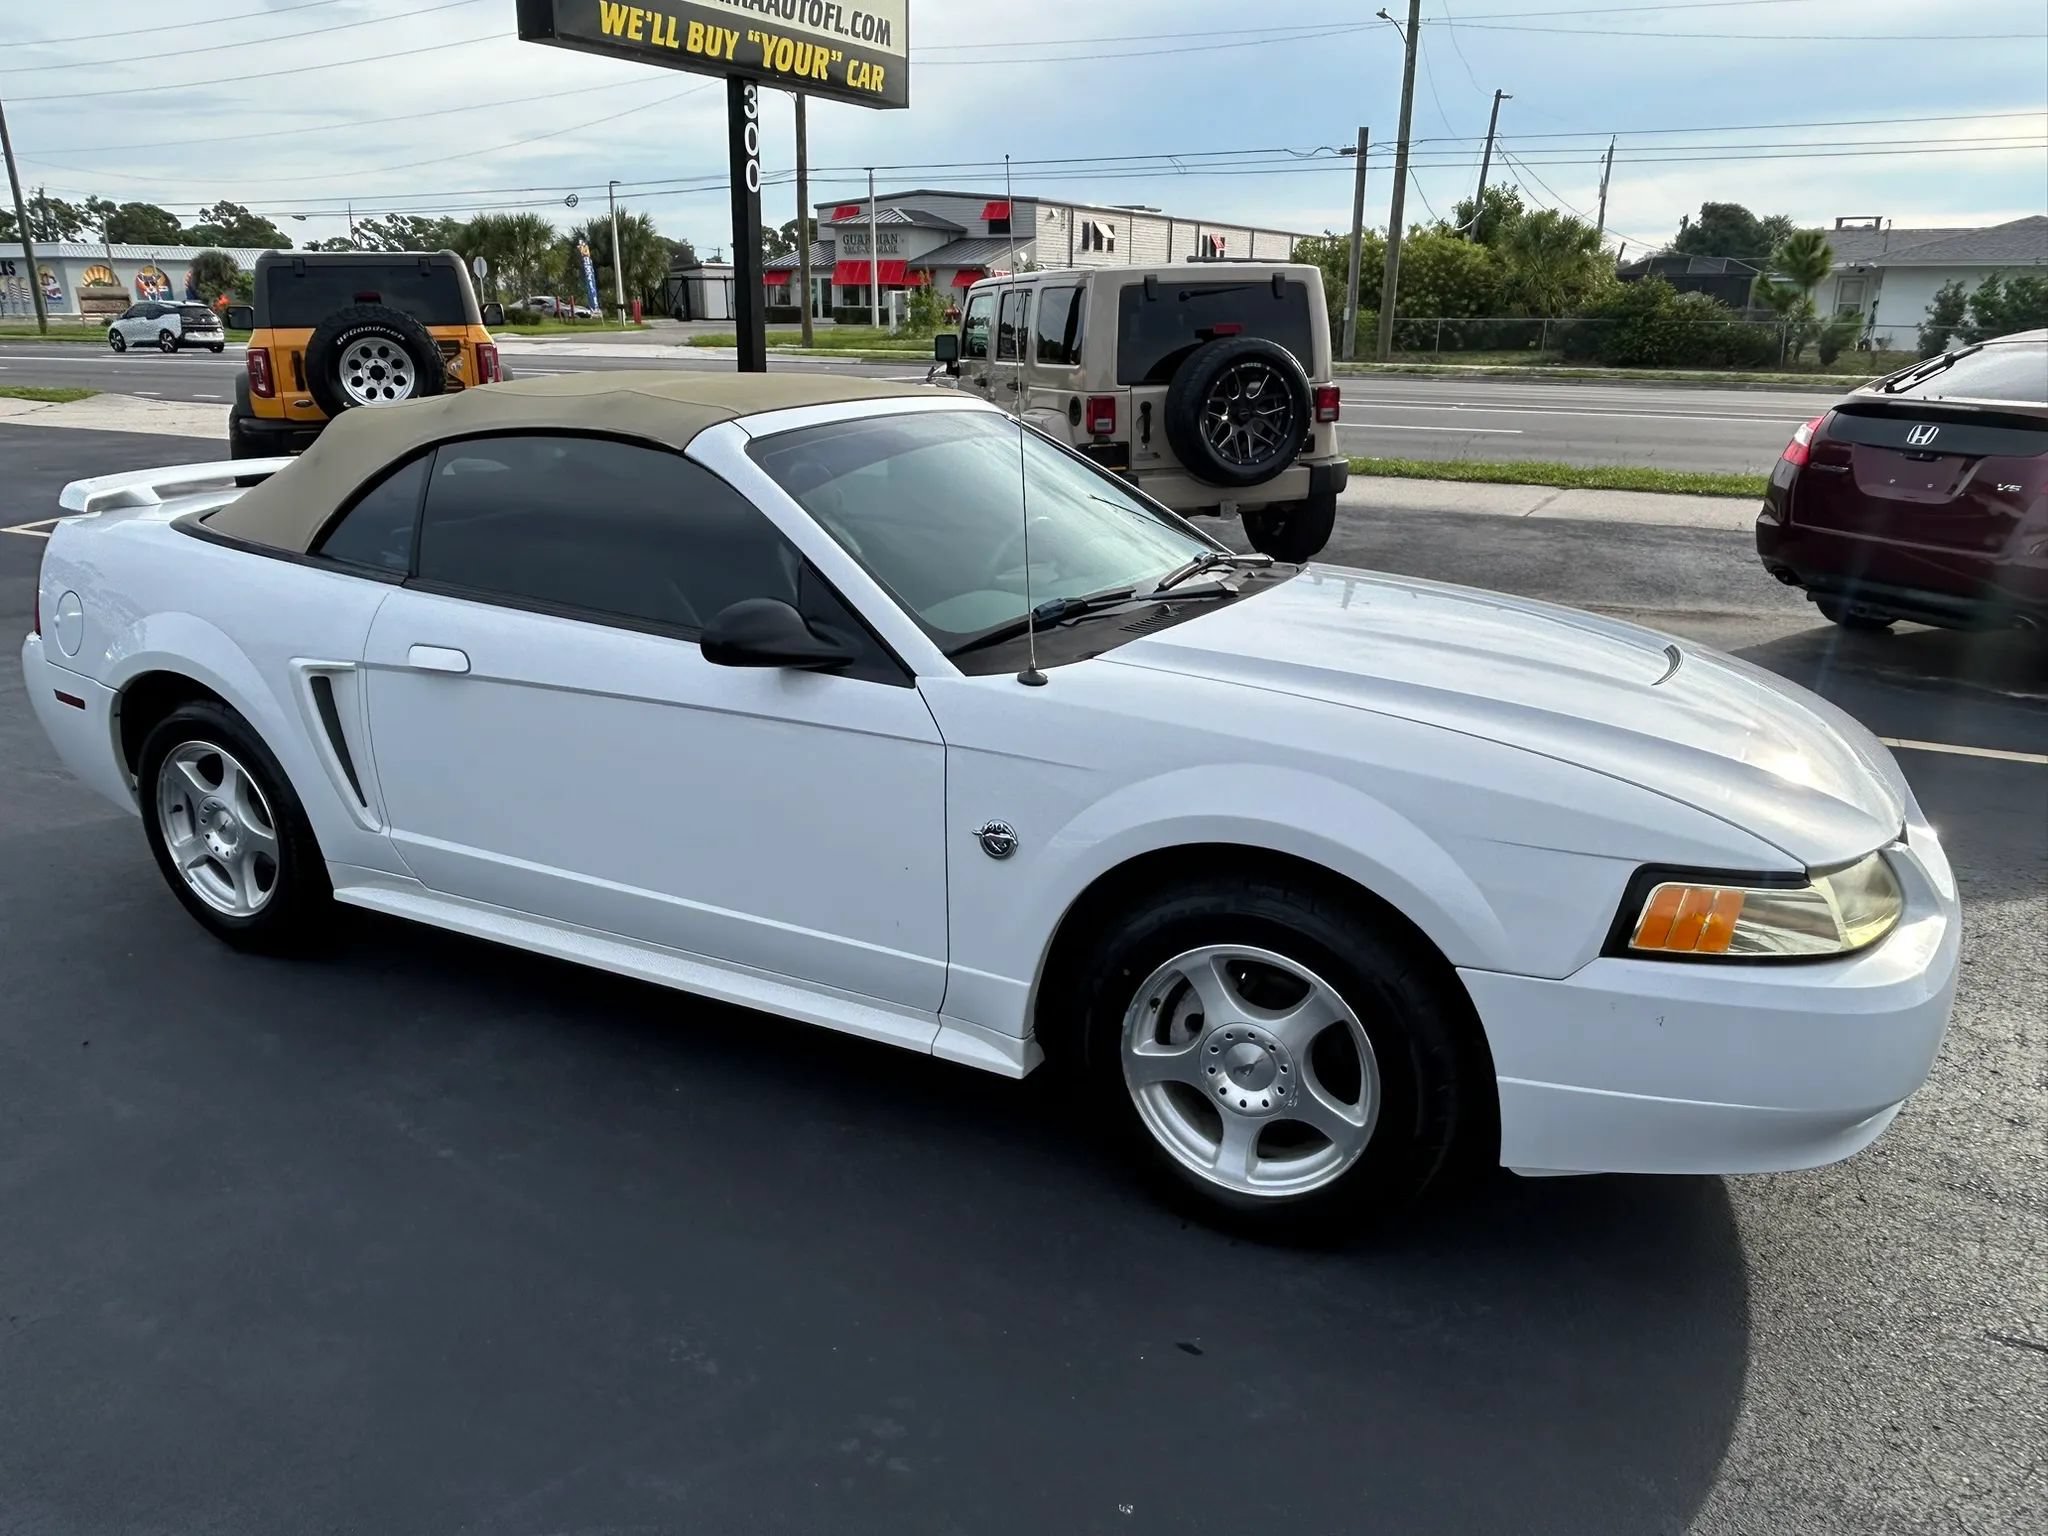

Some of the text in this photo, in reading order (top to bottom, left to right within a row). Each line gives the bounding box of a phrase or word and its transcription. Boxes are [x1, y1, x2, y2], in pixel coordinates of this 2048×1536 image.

[600, 2, 680, 48] WE'LL
[686, 21, 740, 60] BUY
[846, 59, 885, 92] CAR
[744, 84, 760, 193] 300
